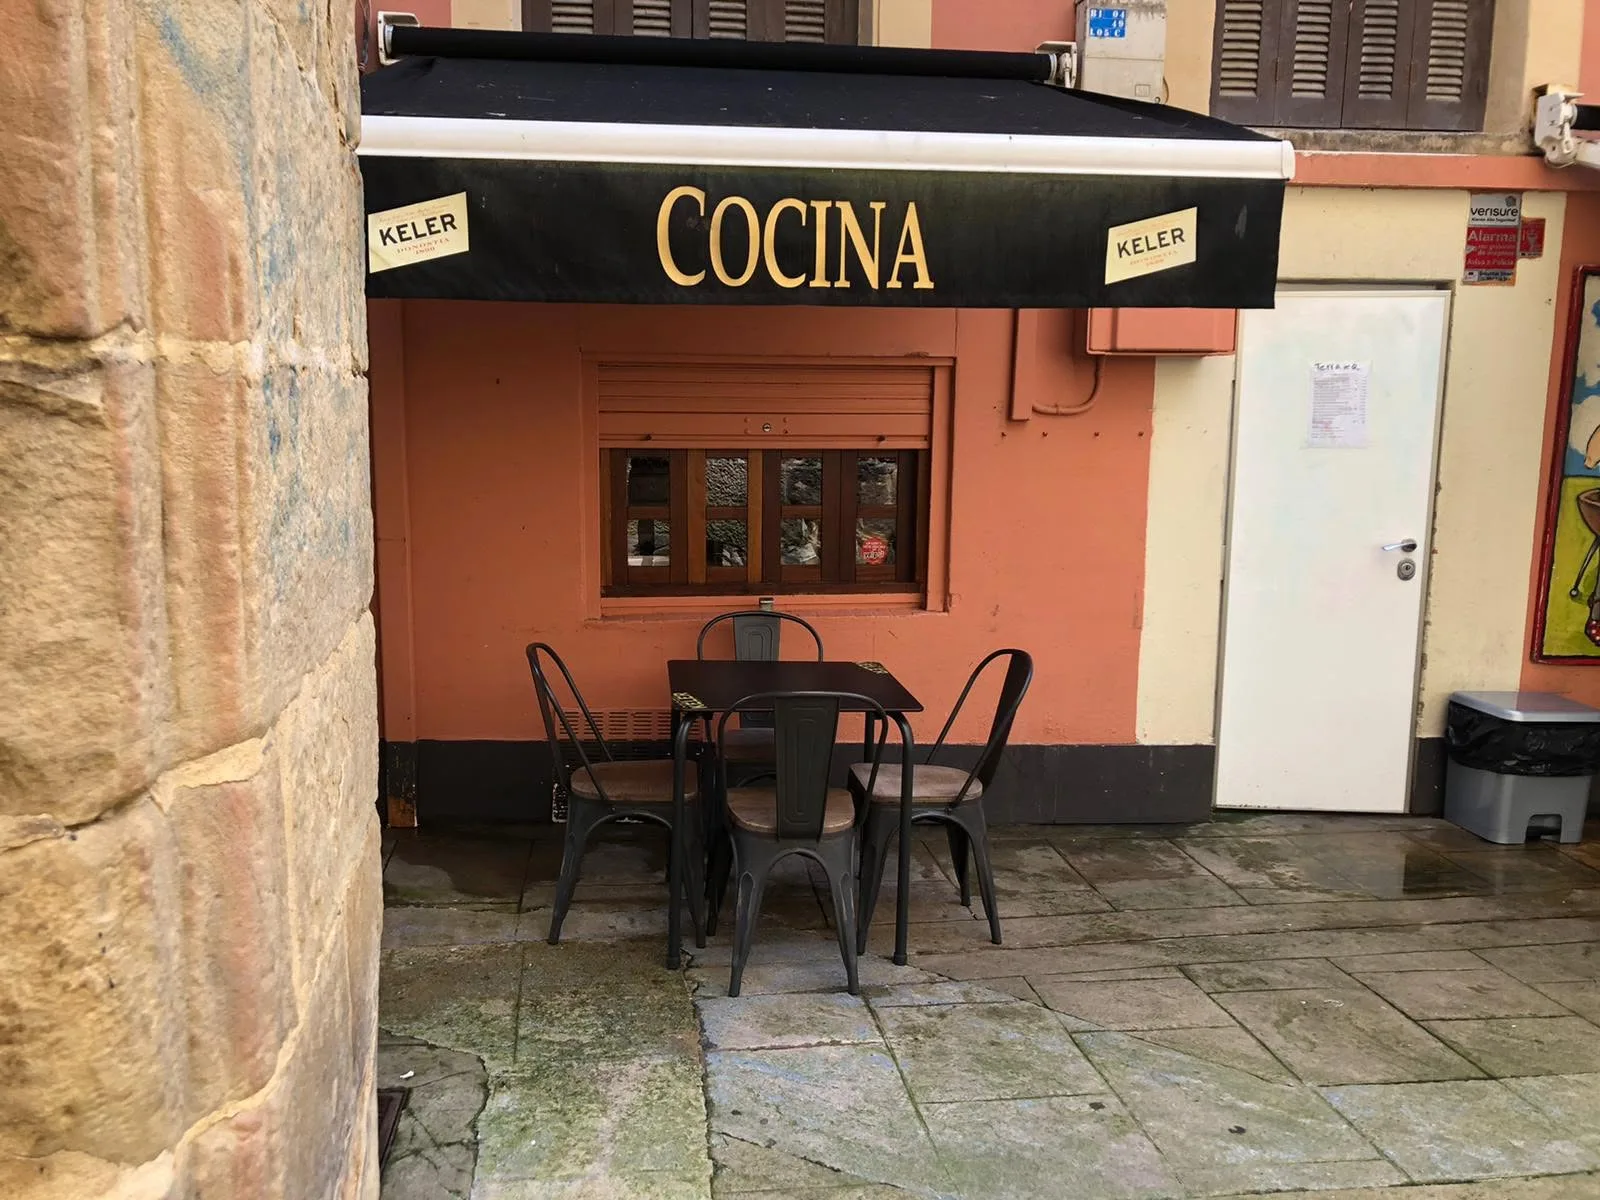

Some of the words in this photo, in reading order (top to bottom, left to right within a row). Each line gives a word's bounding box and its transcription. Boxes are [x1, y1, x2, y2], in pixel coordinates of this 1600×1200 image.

[1470, 207, 1518, 217] verisure
[379, 213, 457, 247] KELER
[656, 185, 935, 290] COCINA
[1117, 227, 1186, 259] KELER
[1468, 230, 1516, 241] Alarma
